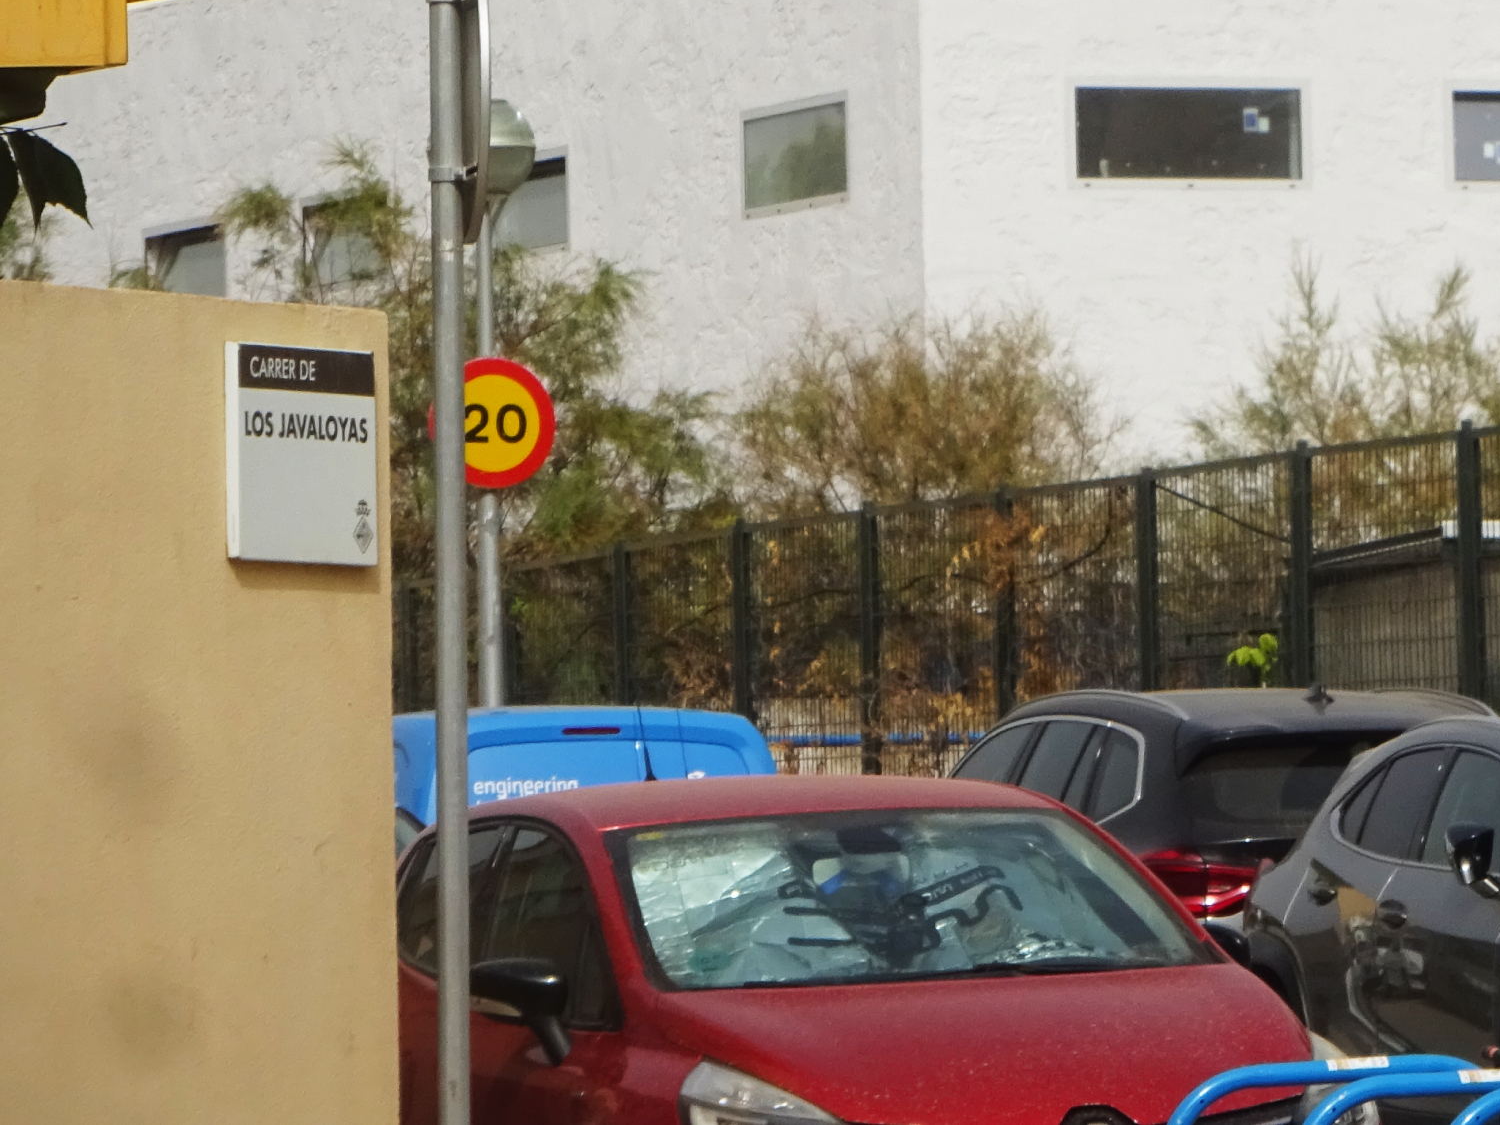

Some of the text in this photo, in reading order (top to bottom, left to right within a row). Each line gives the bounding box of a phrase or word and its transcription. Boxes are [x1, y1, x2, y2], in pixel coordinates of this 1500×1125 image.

[249, 356, 316, 381] CARRER DE
[244, 410, 368, 443] LOS JAVALOYAS
[464, 403, 527, 444] 20
